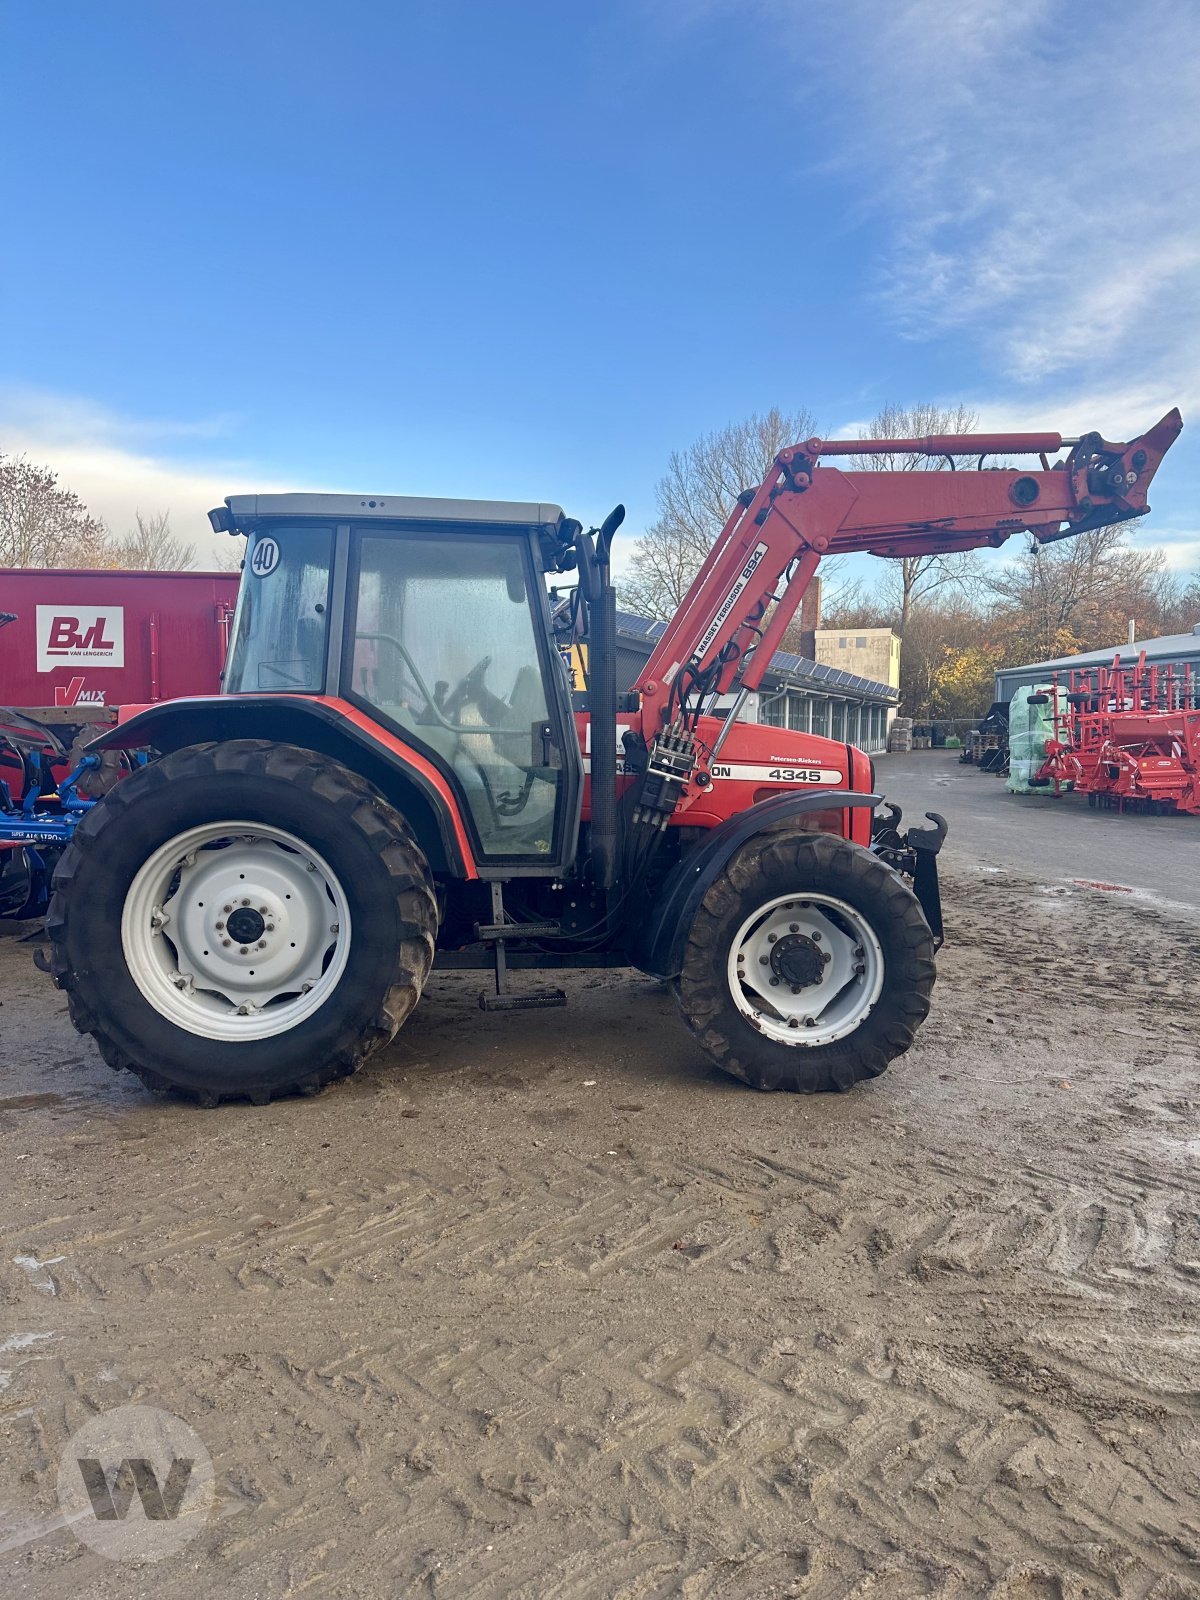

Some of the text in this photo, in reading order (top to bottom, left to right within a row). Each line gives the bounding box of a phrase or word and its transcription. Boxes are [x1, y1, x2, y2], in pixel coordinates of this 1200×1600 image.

[253, 542, 275, 570] 40
[698, 550, 763, 653] MASSEY FERGUSON 894
[770, 755, 822, 764] Petersen-Rickers
[768, 769, 821, 782] 4345
